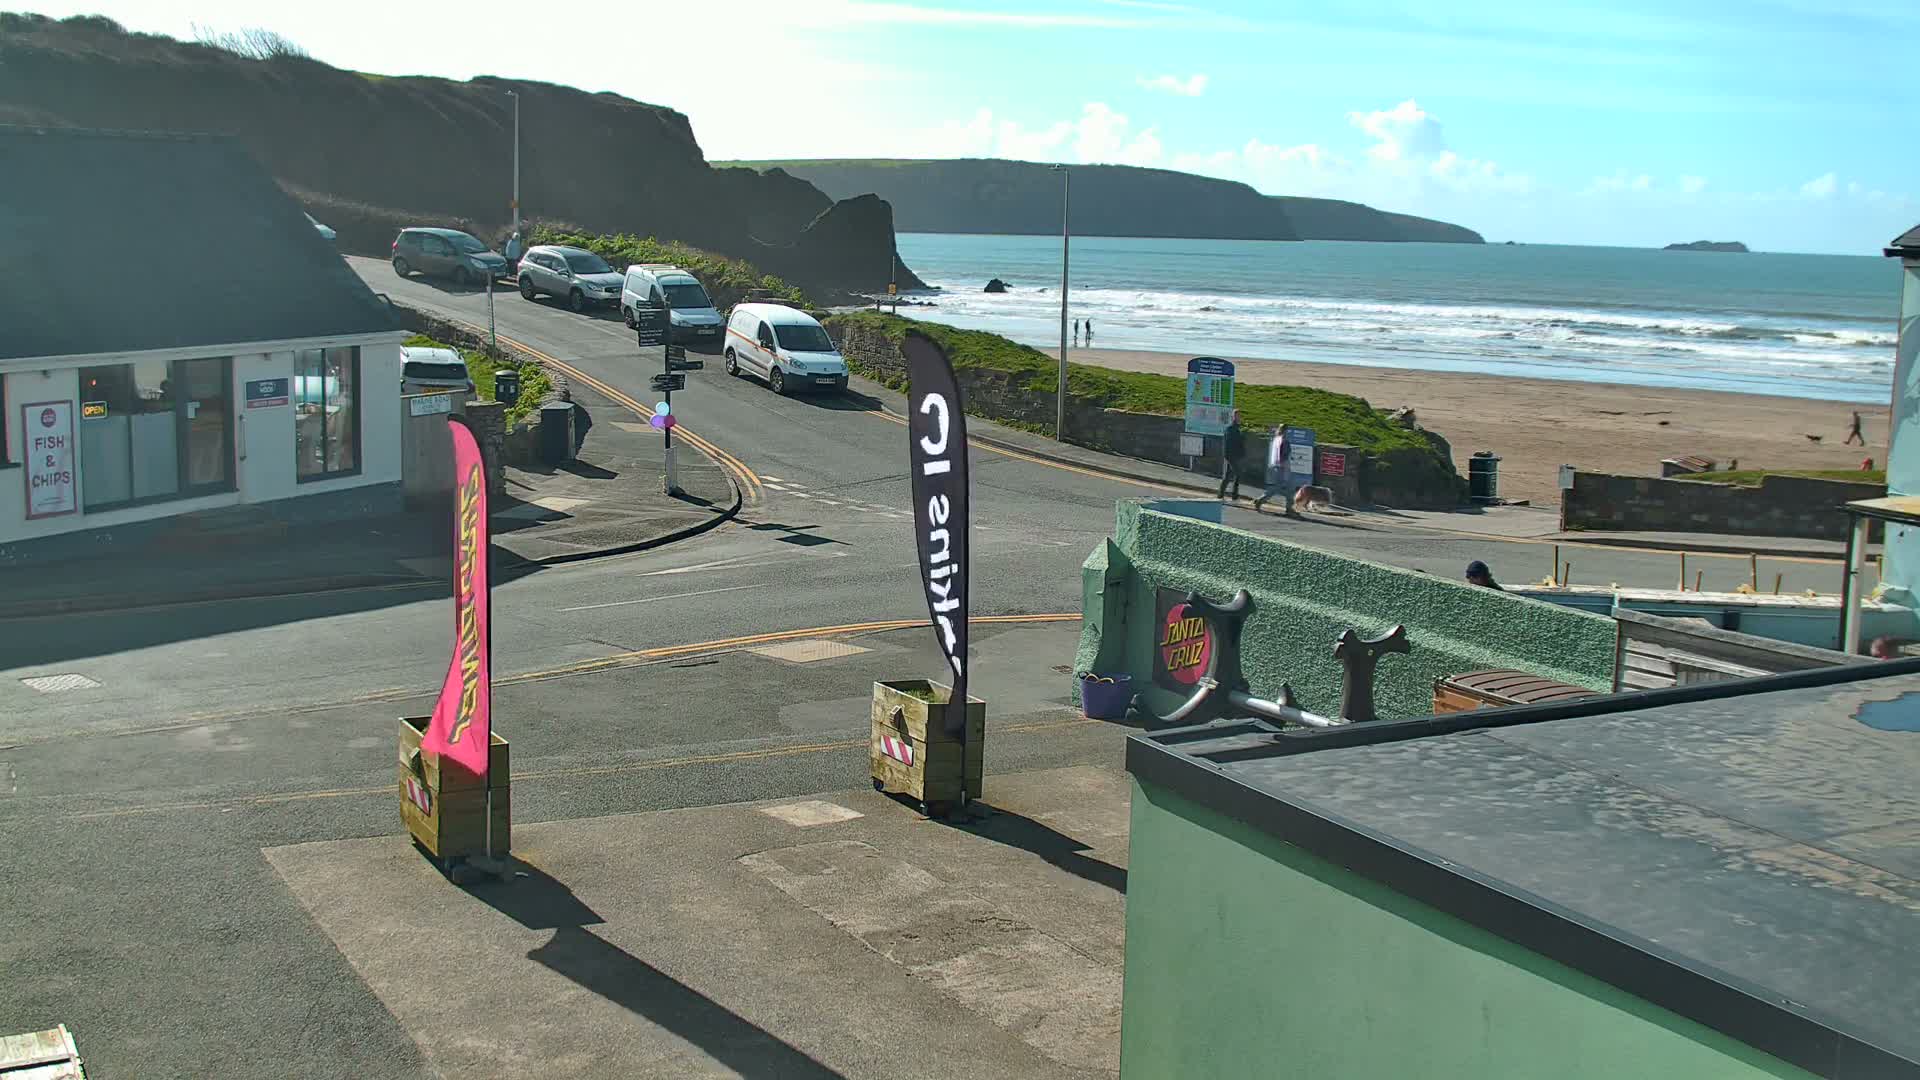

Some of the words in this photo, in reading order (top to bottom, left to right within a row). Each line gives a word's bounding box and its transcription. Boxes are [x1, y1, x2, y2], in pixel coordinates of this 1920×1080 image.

[84, 406, 104, 416] OPEN
[35, 435, 65, 450] FISH
[46, 455, 56, 467] &
[32, 471, 71, 488] CHIPS
[1160, 616, 1205, 647] SANTA
[1168, 641, 1206, 672] CRUZ
